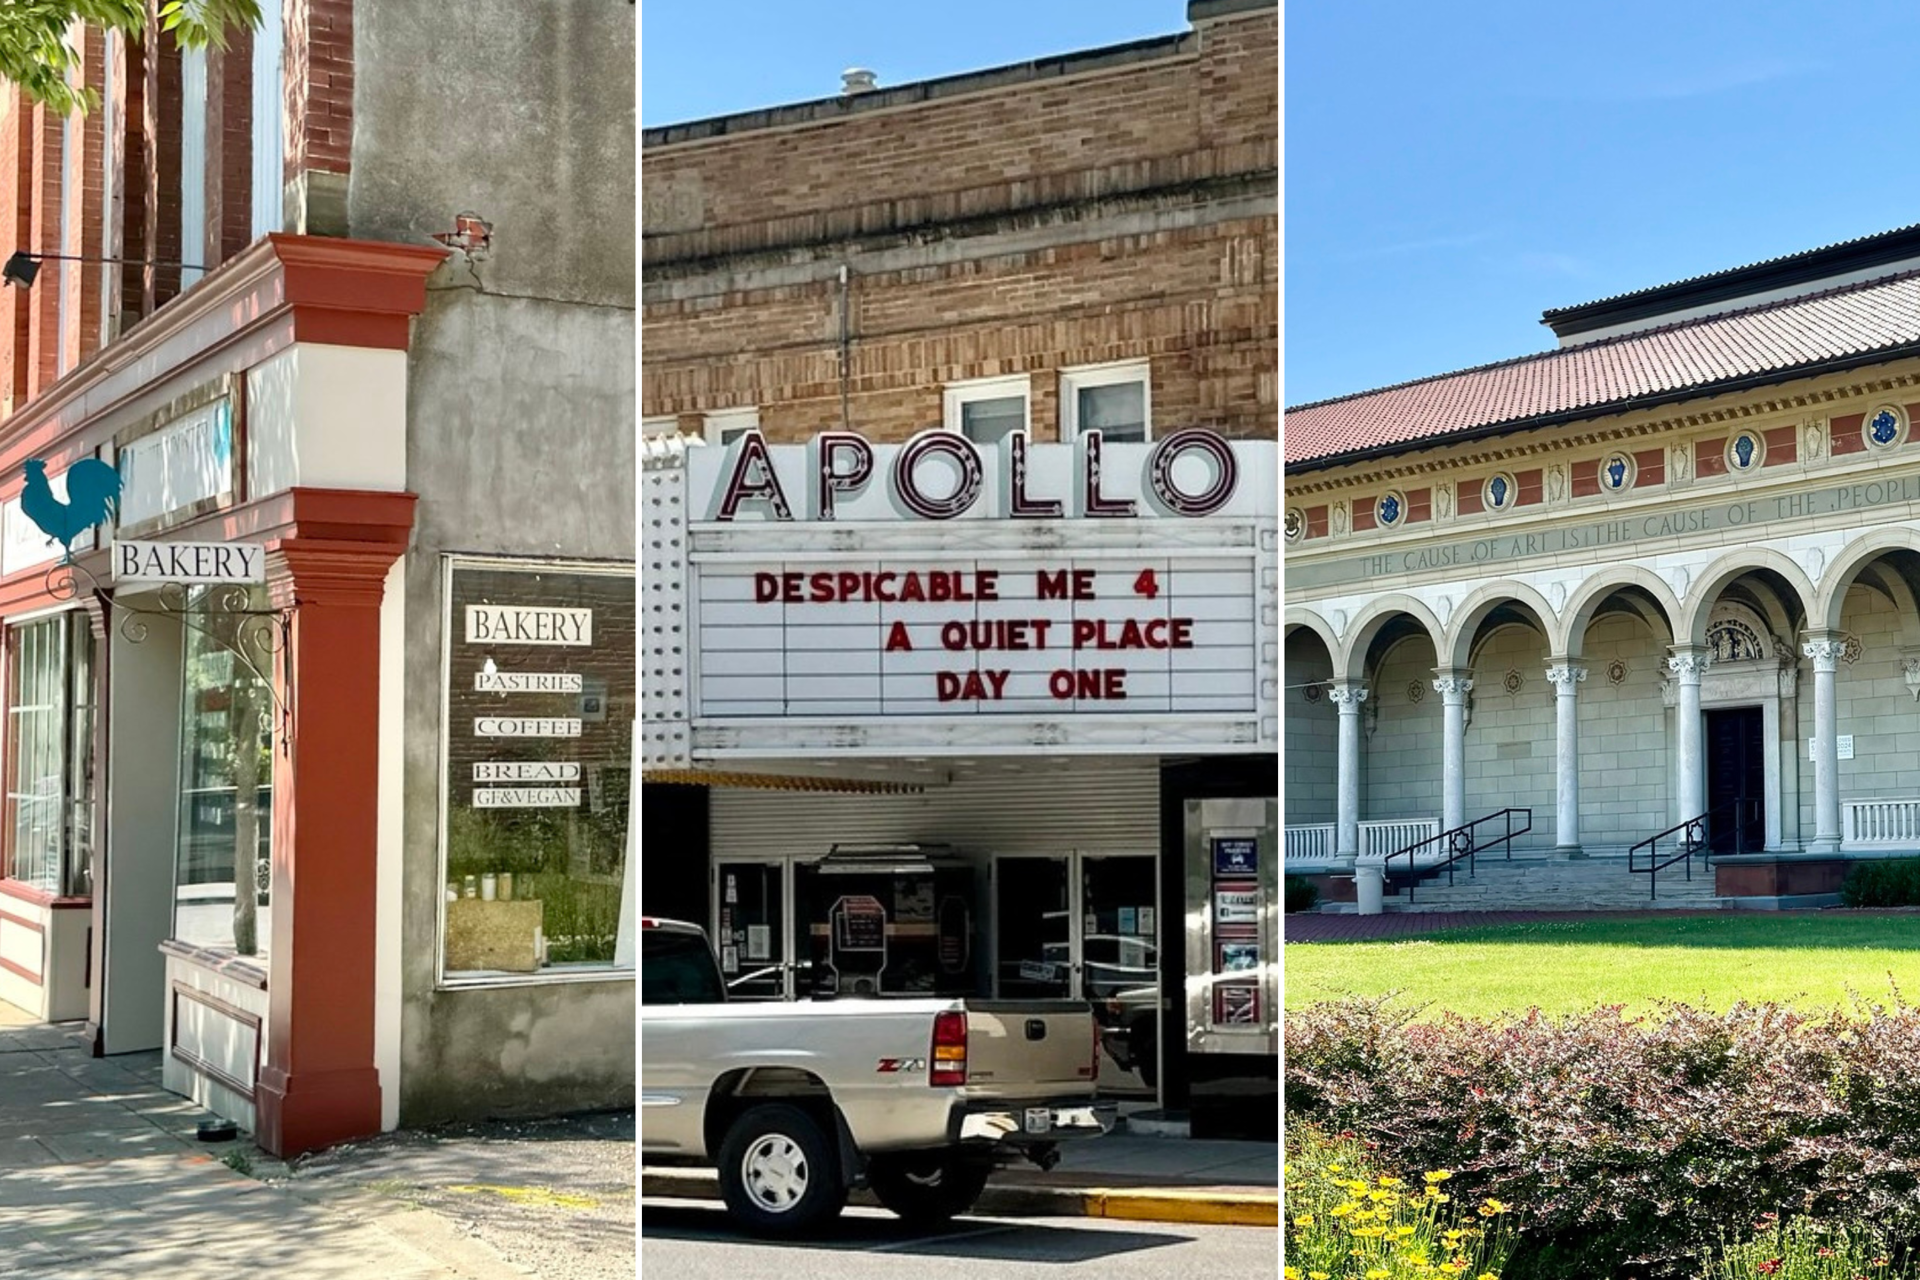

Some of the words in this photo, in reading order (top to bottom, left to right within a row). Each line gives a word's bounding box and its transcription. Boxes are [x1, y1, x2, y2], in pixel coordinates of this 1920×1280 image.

[715, 428, 1240, 522] APOLLO
[1360, 556, 1392, 577] THE
[1403, 545, 1460, 570] CAUSE
[1474, 539, 1499, 562] OF
[1510, 531, 1549, 556] ART
[1562, 528, 1579, 549] IS
[1596, 520, 1632, 544] THE
[1643, 510, 1711, 537] CAUSE
[1728, 501, 1757, 525] OF
[1773, 492, 1817, 519] THE
[1837, 476, 1920, 508] PEOPL
[120, 544, 258, 578] BAKERY
[754, 570, 999, 604] DESPICABLE
[1036, 569, 1096, 601] ME
[1133, 568, 1160, 600] 4
[473, 609, 588, 642] BAKERY
[884, 620, 913, 653] A
[940, 619, 1052, 652] QUIET
[1072, 618, 1194, 650] PLACE
[478, 674, 582, 691] PASTRIES
[936, 669, 1011, 703] DAY
[1049, 668, 1127, 700] ONE
[477, 719, 581, 736] COFFEE
[475, 764, 580, 779] BREAD
[476, 789, 577, 805] GF&VEGAN
[876, 1057, 926, 1073] Z71
